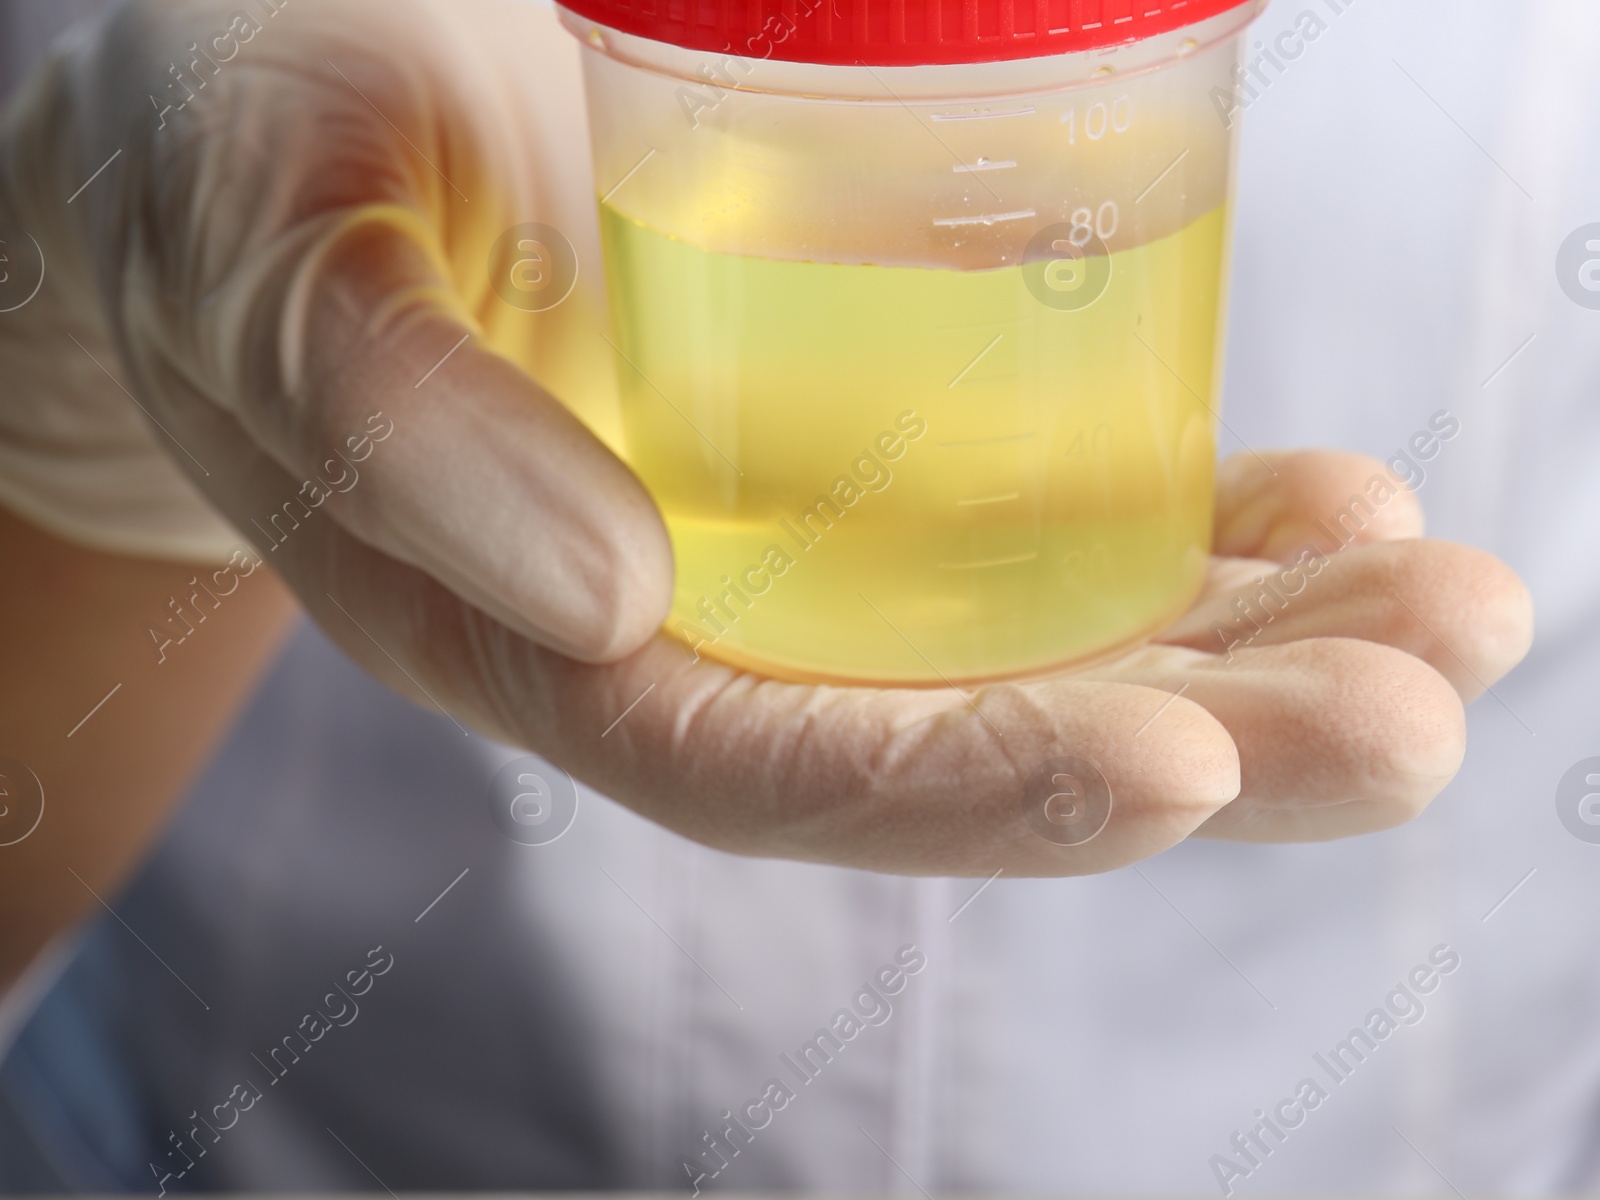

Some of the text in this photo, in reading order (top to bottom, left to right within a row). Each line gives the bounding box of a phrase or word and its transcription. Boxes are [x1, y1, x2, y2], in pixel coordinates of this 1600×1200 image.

[1059, 93, 1134, 146] 100
[1068, 200, 1119, 248] 80
[1064, 422, 1114, 462] 40
